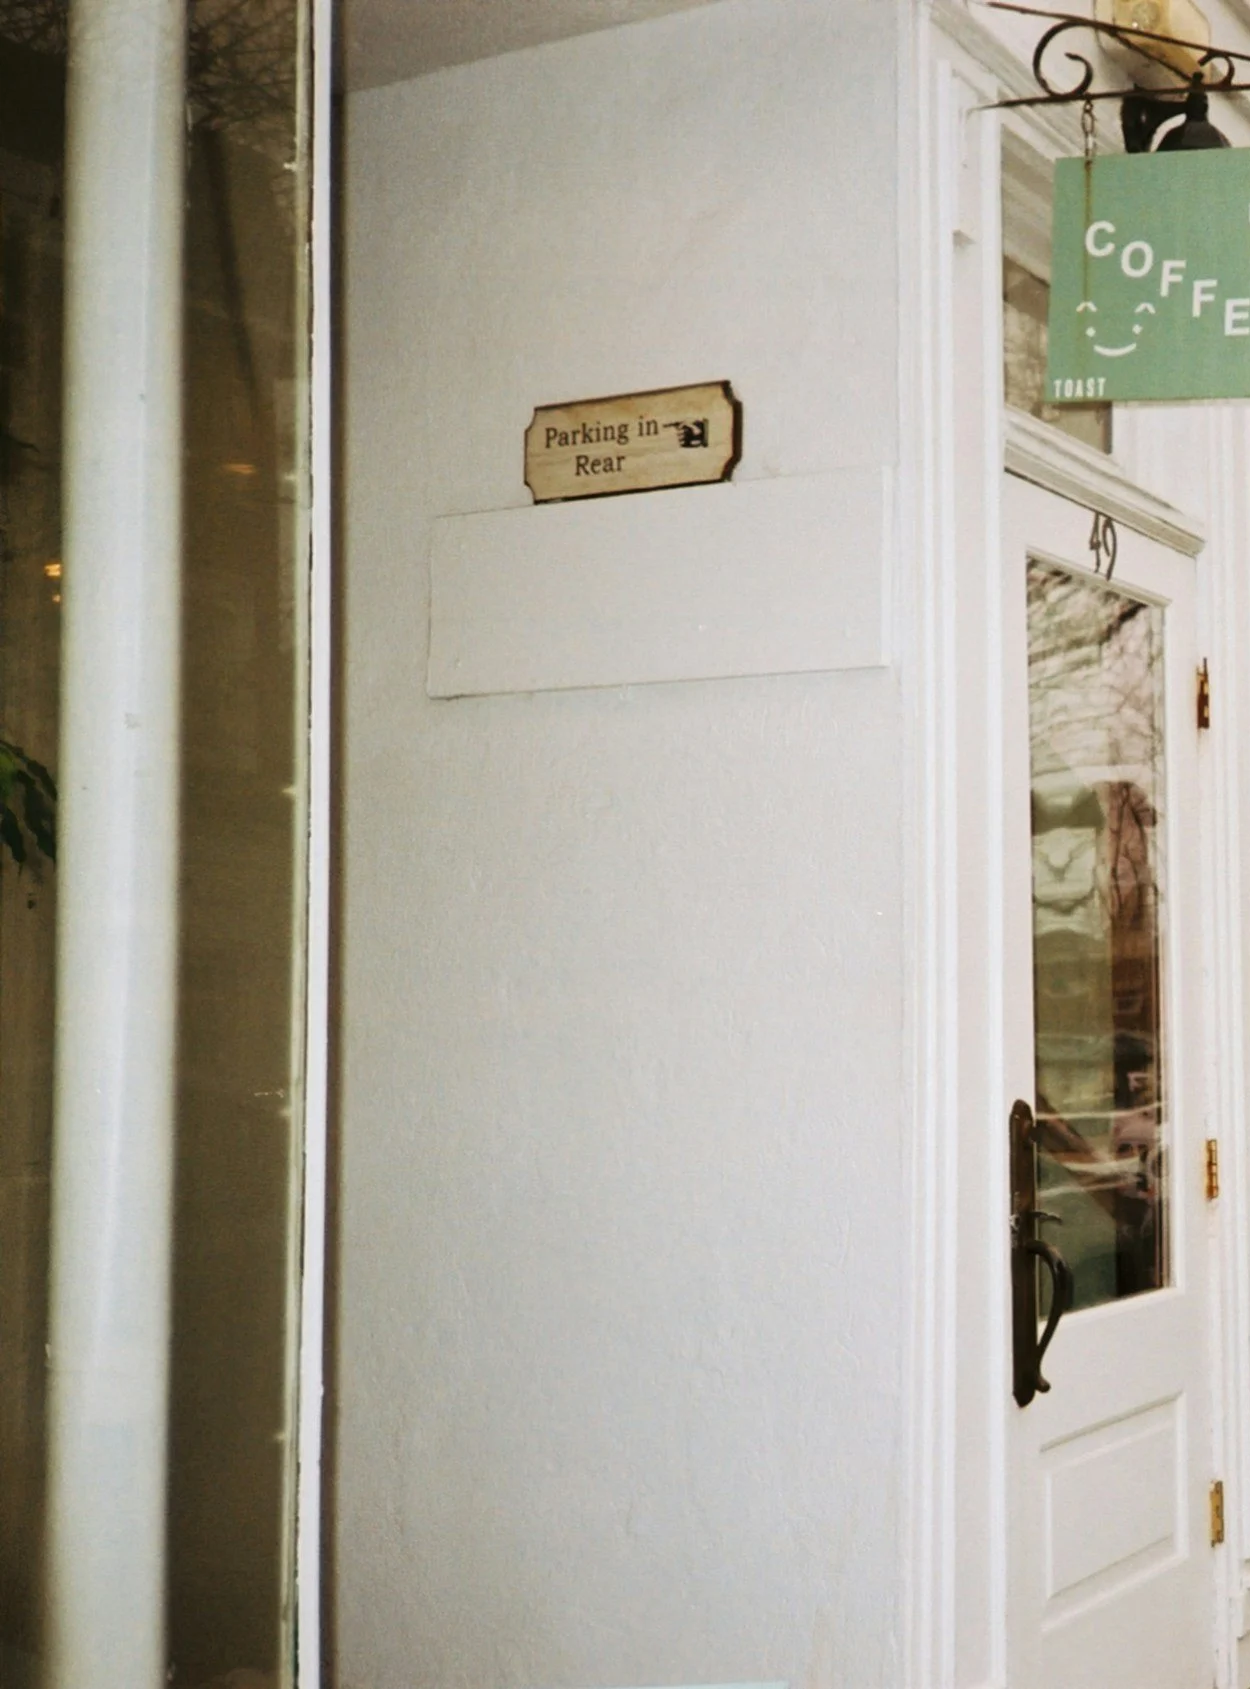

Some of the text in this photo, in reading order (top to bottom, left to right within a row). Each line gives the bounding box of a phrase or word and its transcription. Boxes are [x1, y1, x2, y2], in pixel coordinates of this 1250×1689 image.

[1054, 377, 1107, 399] TOAST
[544, 415, 659, 449] Parking in
[574, 454, 626, 477] Rear
